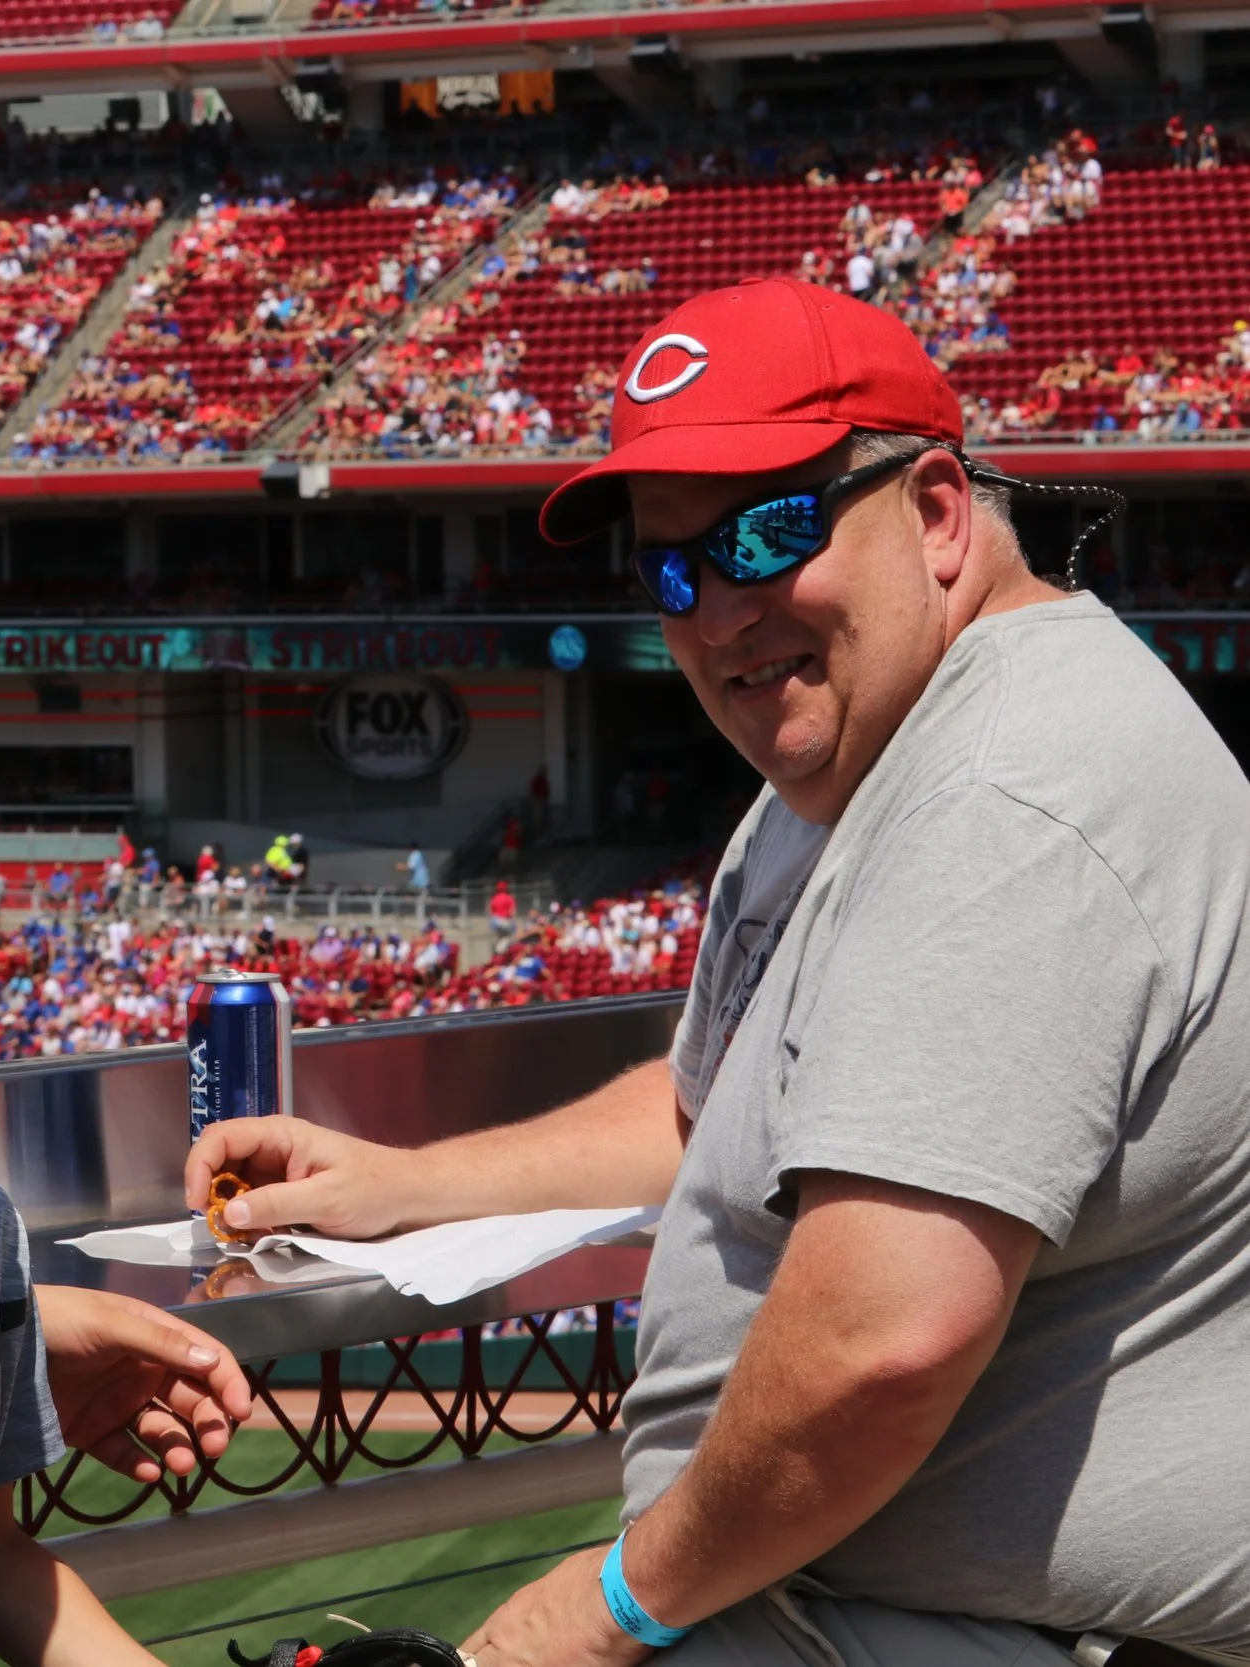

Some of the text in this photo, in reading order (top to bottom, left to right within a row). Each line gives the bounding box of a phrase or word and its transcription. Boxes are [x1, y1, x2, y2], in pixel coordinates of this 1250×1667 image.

[624, 332, 709, 404] C
[271, 628, 502, 668] STRIKEOUT
[348, 690, 430, 736] FOX
